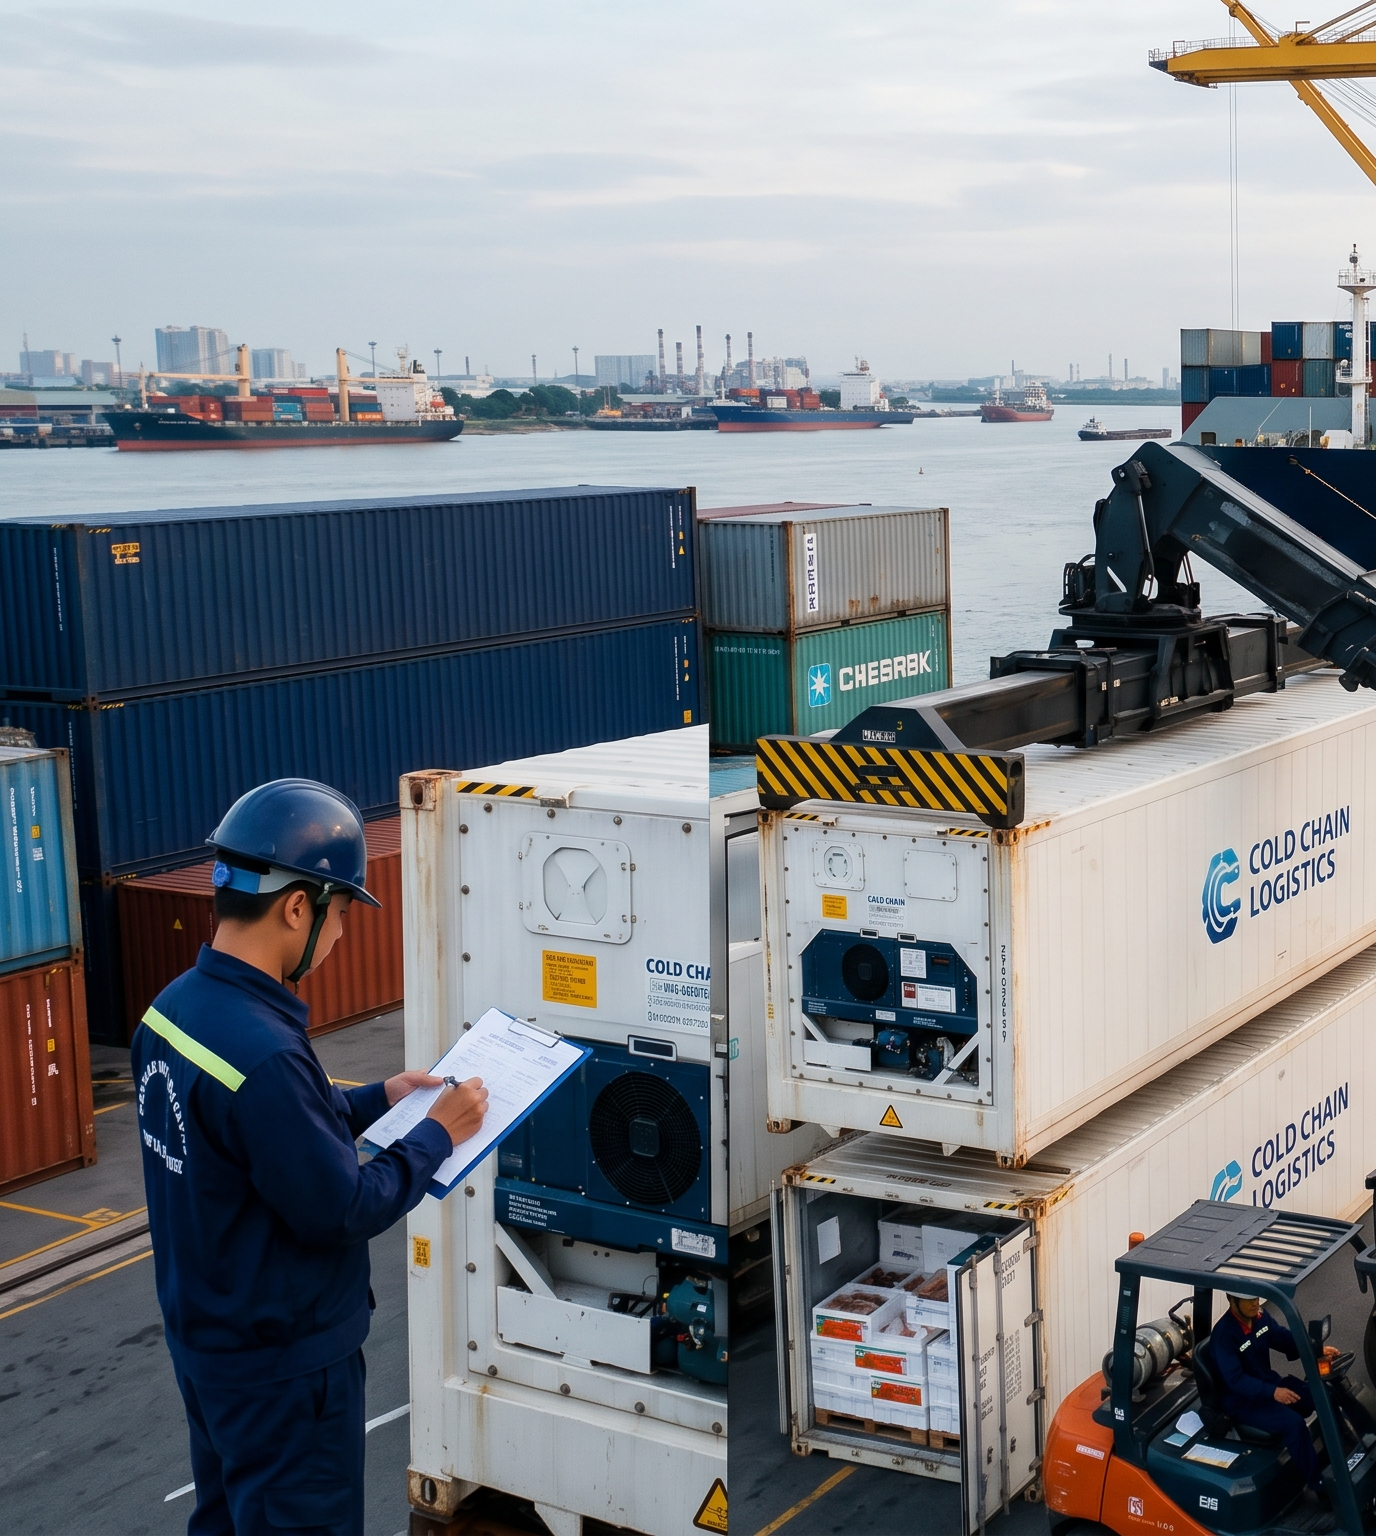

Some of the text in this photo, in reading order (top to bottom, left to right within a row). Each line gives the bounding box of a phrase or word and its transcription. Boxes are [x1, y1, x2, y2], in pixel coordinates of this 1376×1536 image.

[1249, 805, 1351, 875] COLD CHAIN
[885, 897, 906, 907] CHAIN
[1250, 848, 1336, 918] LOGISTICS
[645, 958, 683, 977] COLD
[1251, 1081, 1350, 1178] COLD CHAIN
